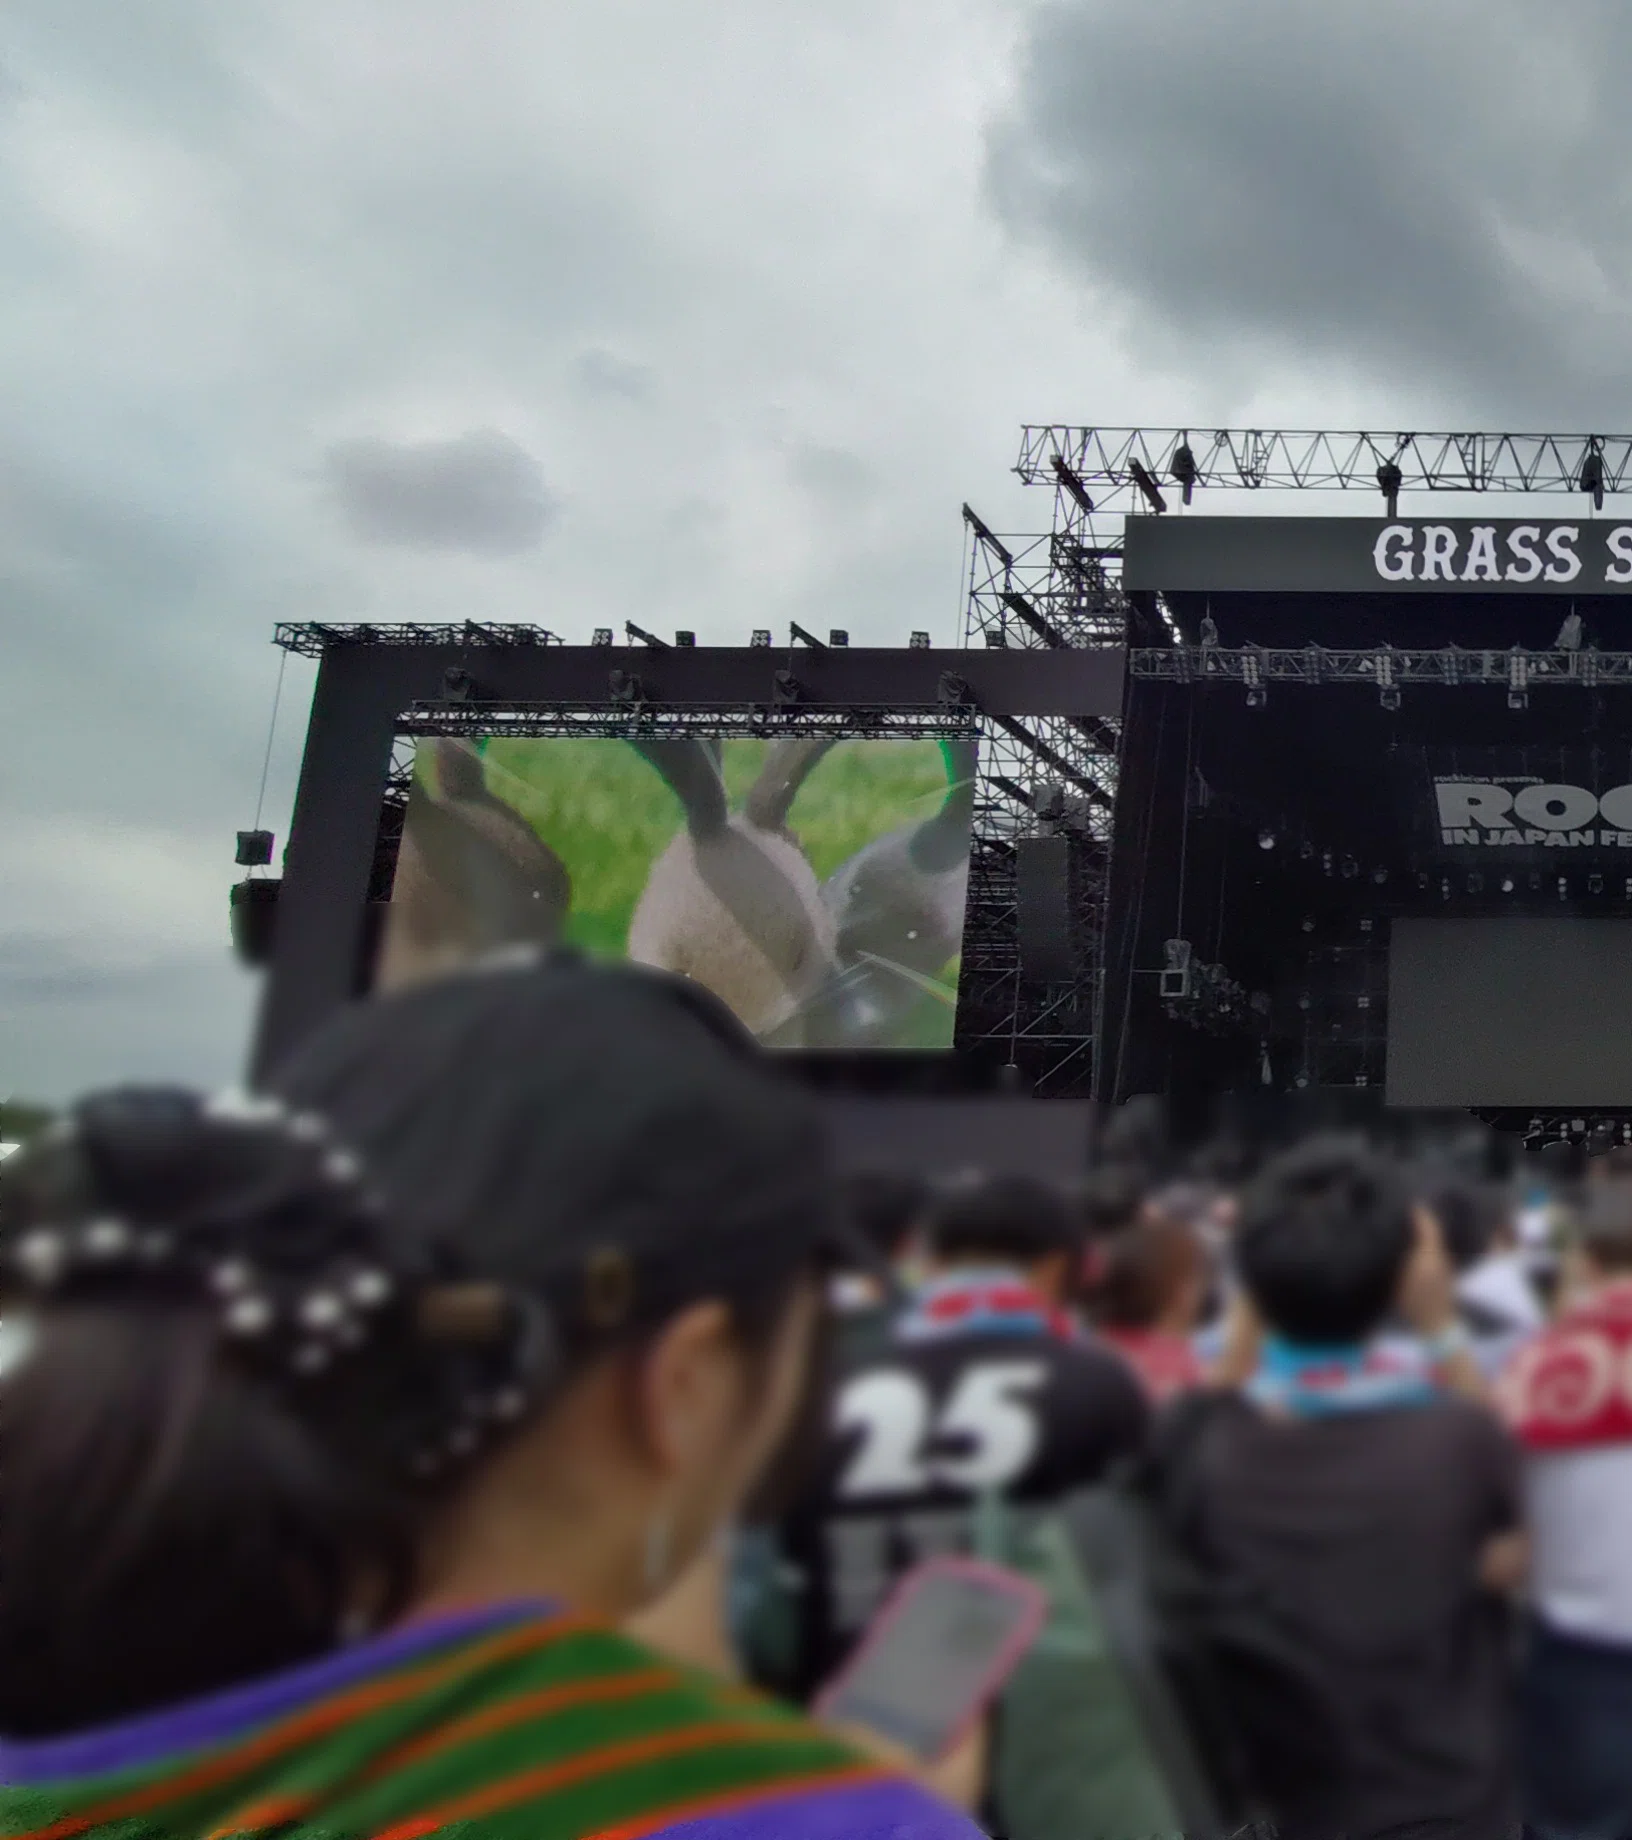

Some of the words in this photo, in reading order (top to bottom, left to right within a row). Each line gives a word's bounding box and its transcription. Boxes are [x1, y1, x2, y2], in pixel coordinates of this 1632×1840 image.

[1372, 525, 1583, 583] GRASS
[1441, 829, 1479, 845] IN
[1484, 829, 1595, 847] JAPAN
[834, 1362, 1047, 1494] 25
